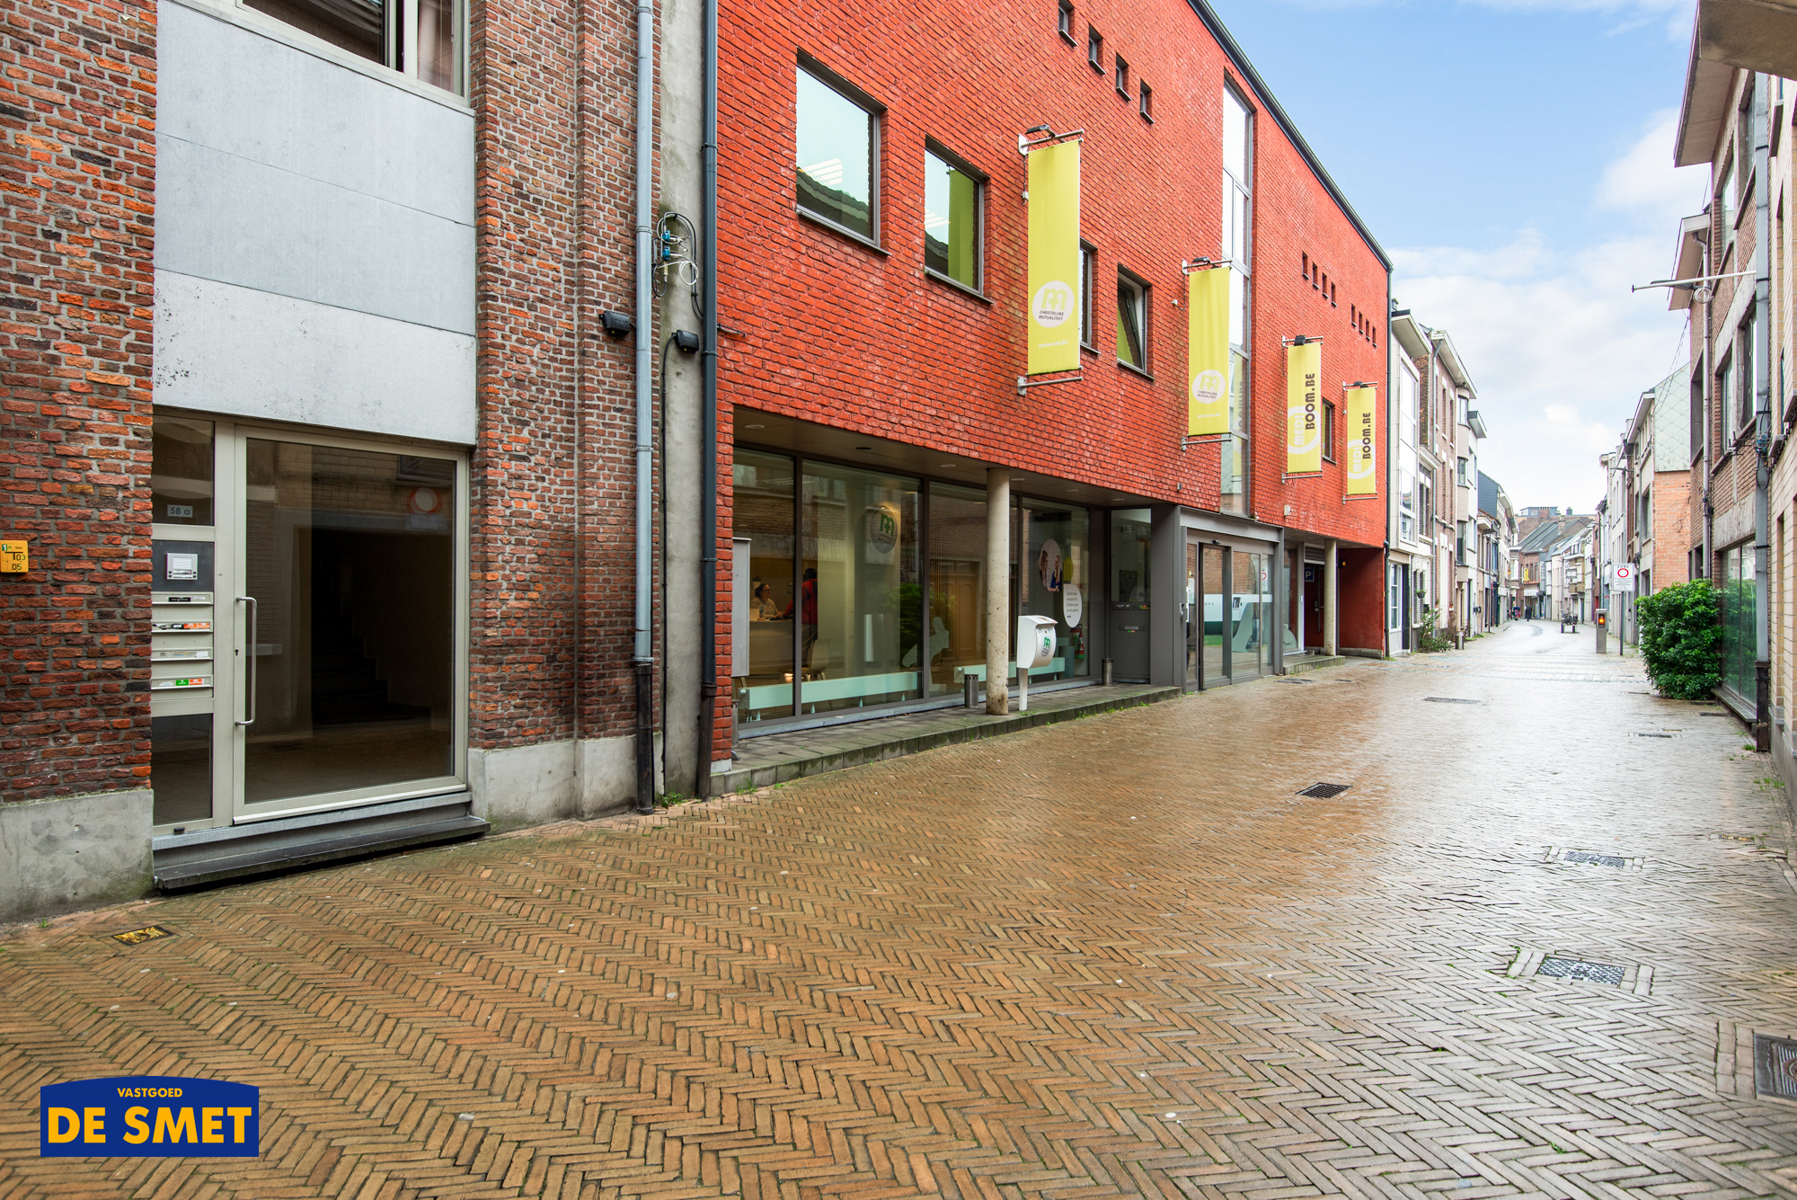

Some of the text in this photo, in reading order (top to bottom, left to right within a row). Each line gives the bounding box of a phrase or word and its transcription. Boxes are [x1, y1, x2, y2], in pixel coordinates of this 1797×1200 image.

[1038, 339, 1068, 348] www.cm.be
[1305, 373, 1315, 430] BOOM.BE
[1294, 415, 1304, 446] MEDI
[1362, 413, 1371, 459] BOOM.BE
[1353, 447, 1362, 472] MEDI
[170, 507, 181, 515] 58
[1305, 571, 1311, 579] P
